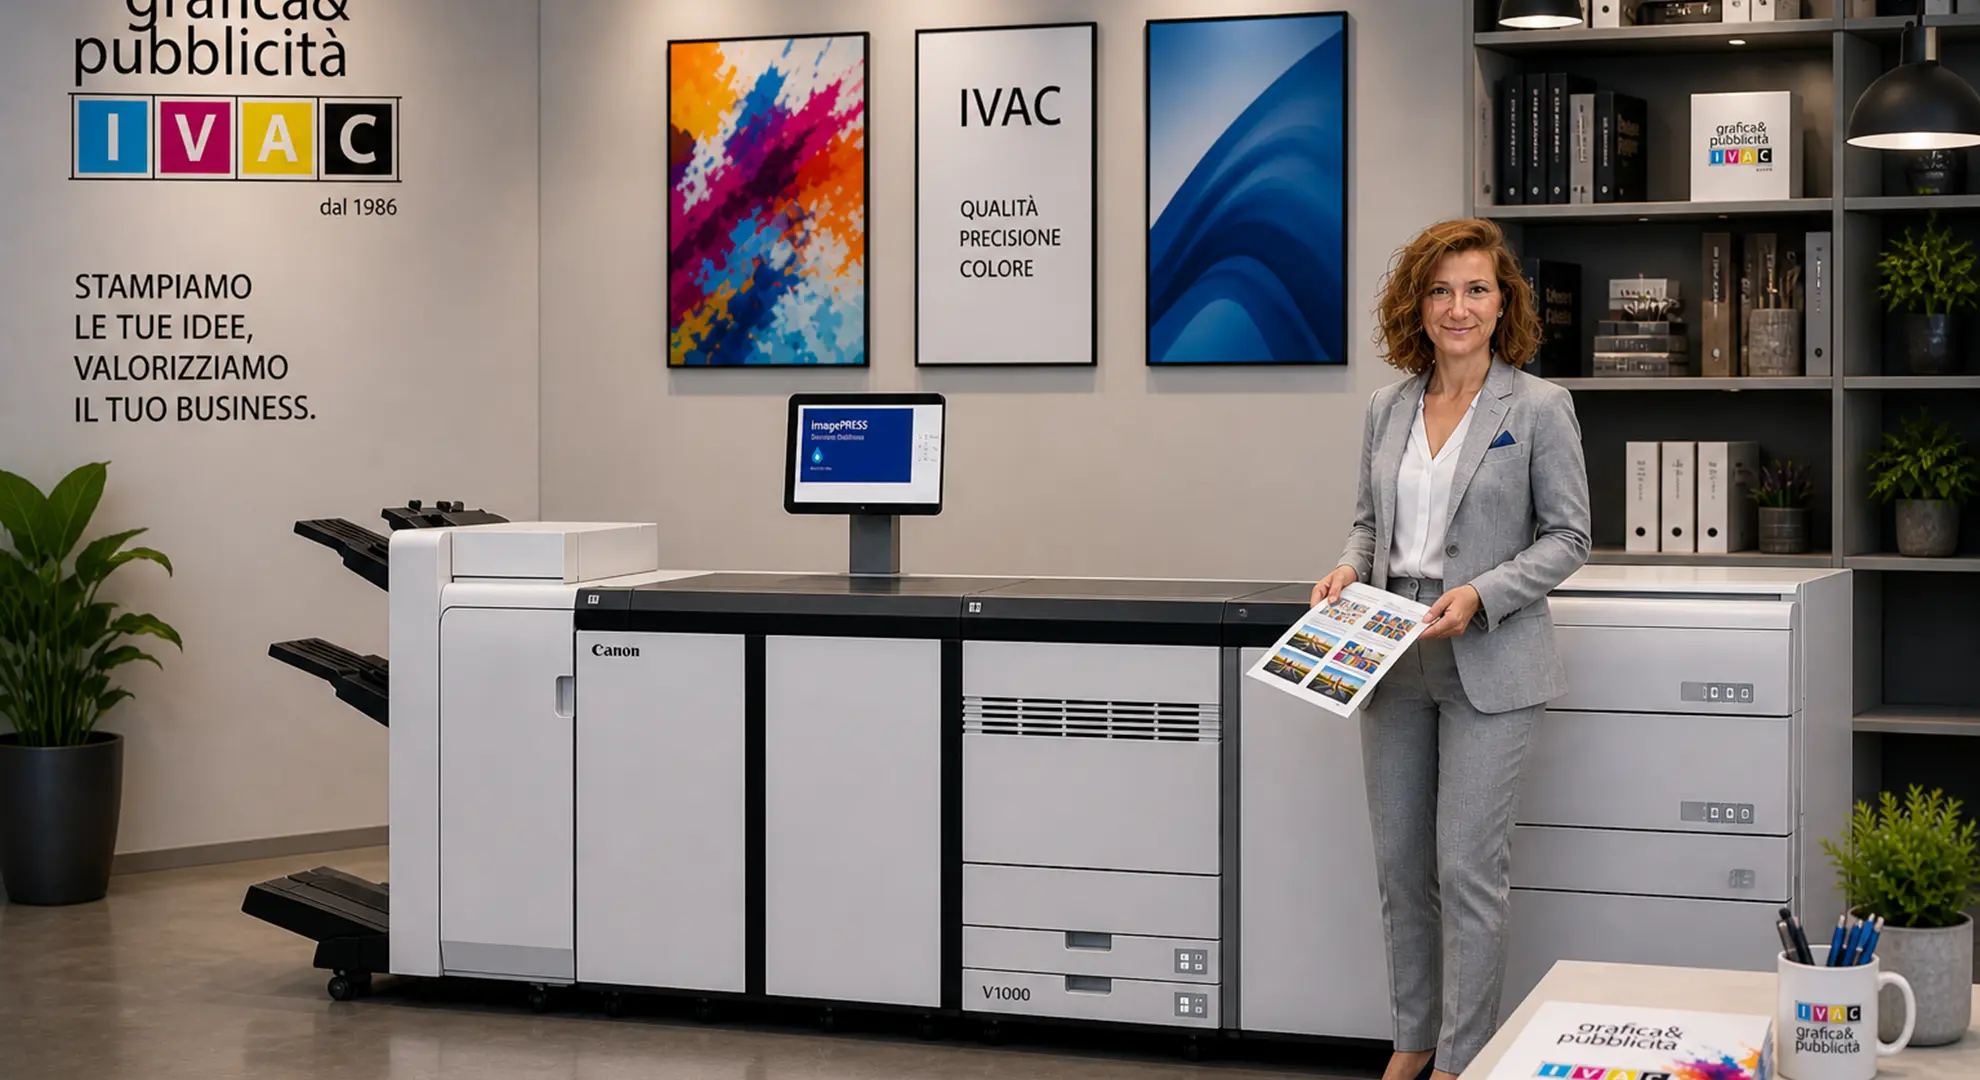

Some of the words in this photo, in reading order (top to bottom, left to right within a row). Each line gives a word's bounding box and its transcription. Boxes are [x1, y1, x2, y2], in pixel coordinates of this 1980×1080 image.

[75, 25, 347, 87] pubblicità
[961, 85, 1061, 127] IVAC
[1716, 121, 1767, 135] grafica&
[107, 112, 378, 164] IVAC
[1715, 150, 1769, 163] IVAC
[320, 197, 347, 216] dal
[353, 197, 398, 216] 1986
[960, 195, 1039, 220] QUALITÀ
[960, 228, 1061, 247] PRECISIONE
[960, 259, 1034, 278] COLORE
[75, 273, 253, 300] STAMPIAMO
[75, 314, 107, 340] LE
[115, 314, 173, 340] TUE
[183, 314, 254, 345] IDEE,
[74, 354, 289, 381] VALORIZZIAMO
[75, 396, 99, 423] IL
[105, 396, 168, 423] TUO
[177, 394, 317, 422] BUSINESS.
[591, 643, 641, 657] Canon
[982, 985, 1031, 1001] V1000
[1801, 1005, 1859, 1020] IVAC
[1578, 1022, 1683, 1040] grafica&
[1796, 1026, 1854, 1040] grafica&
